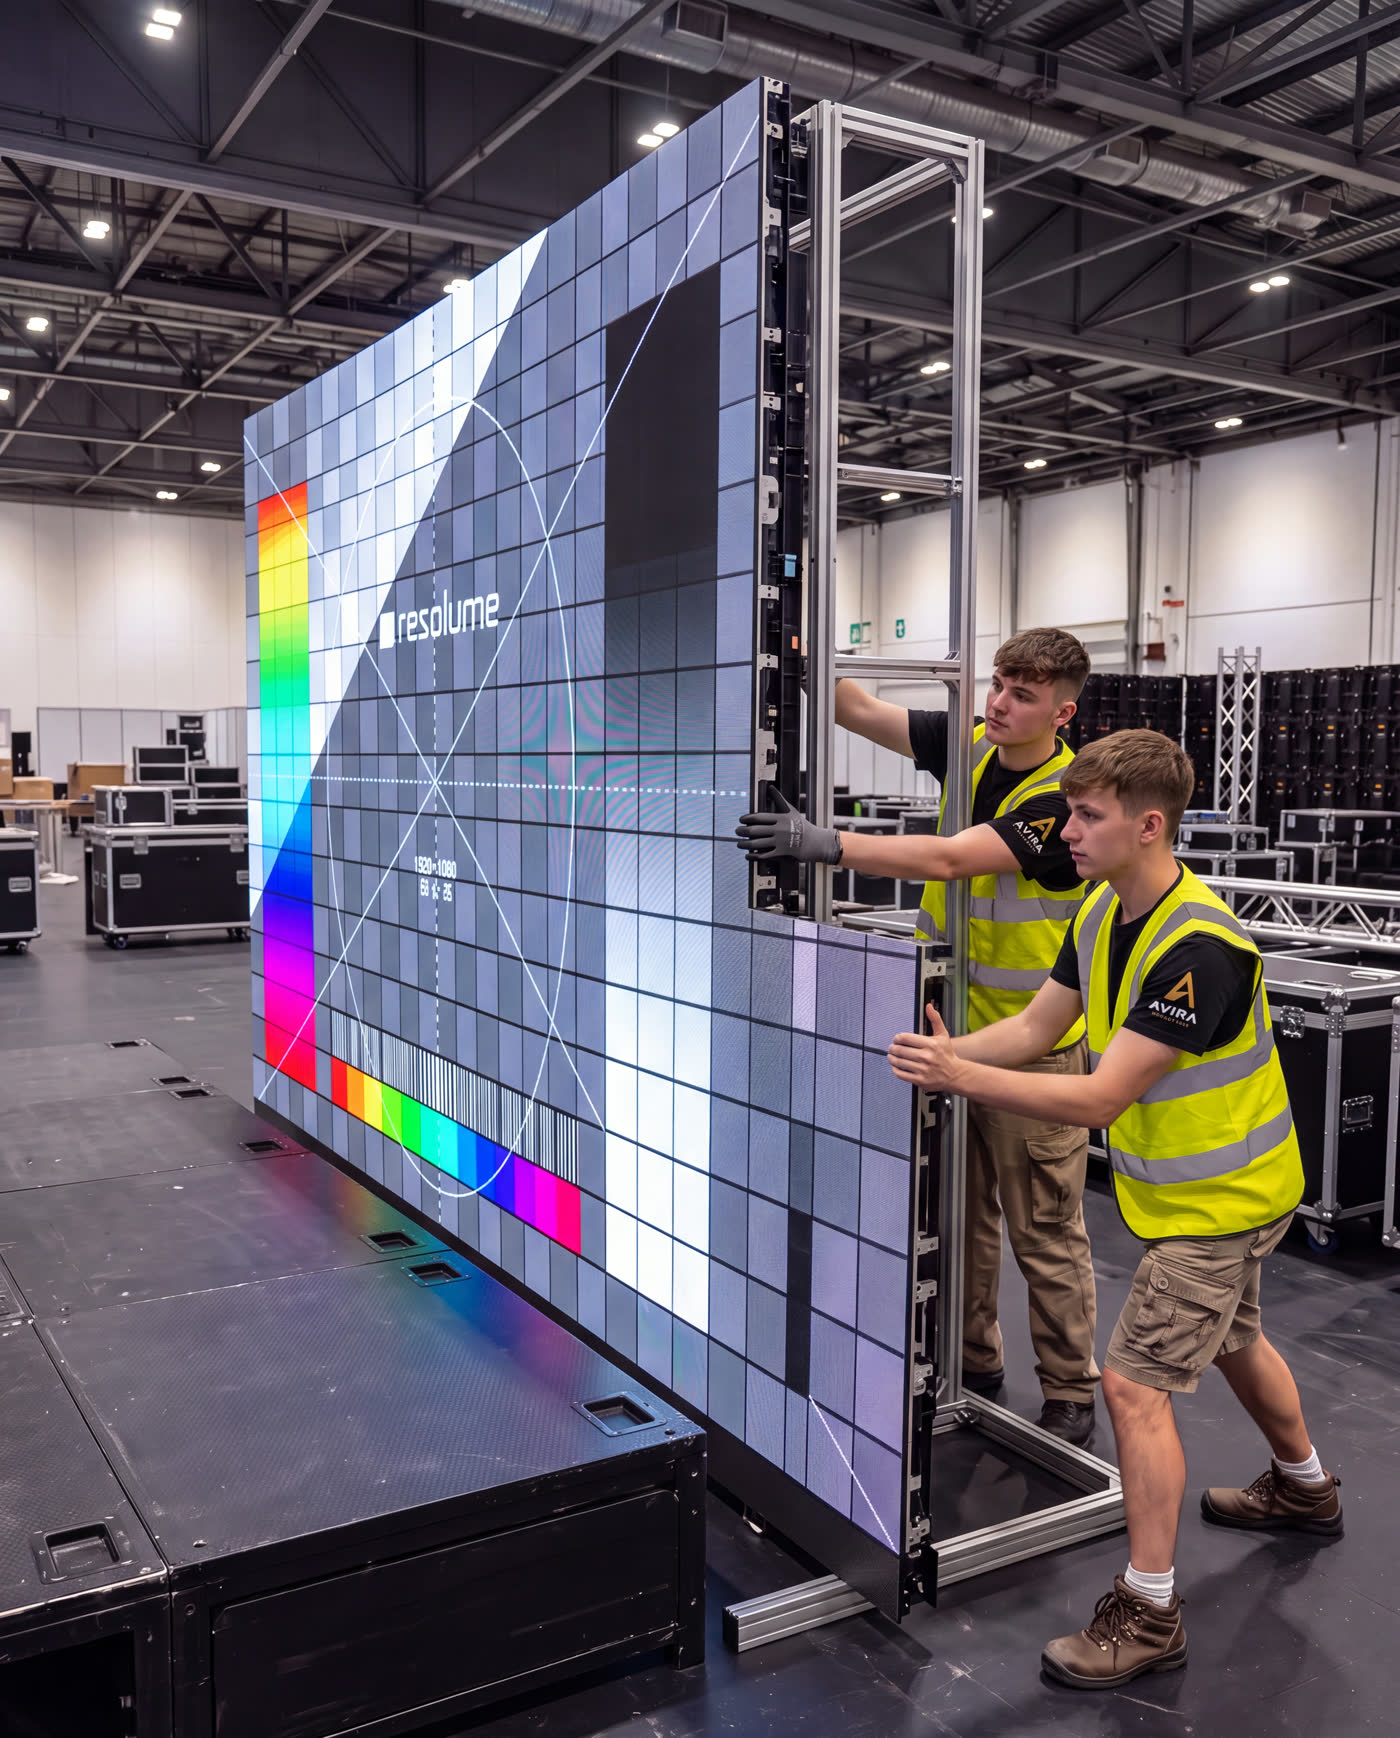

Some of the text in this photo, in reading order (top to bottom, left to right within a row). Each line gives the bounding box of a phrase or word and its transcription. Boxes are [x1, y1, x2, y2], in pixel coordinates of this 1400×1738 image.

[398, 589, 499, 643] resolume
[1012, 821, 1043, 854] AVIRA
[1148, 1000, 1197, 1025] AVIRA
